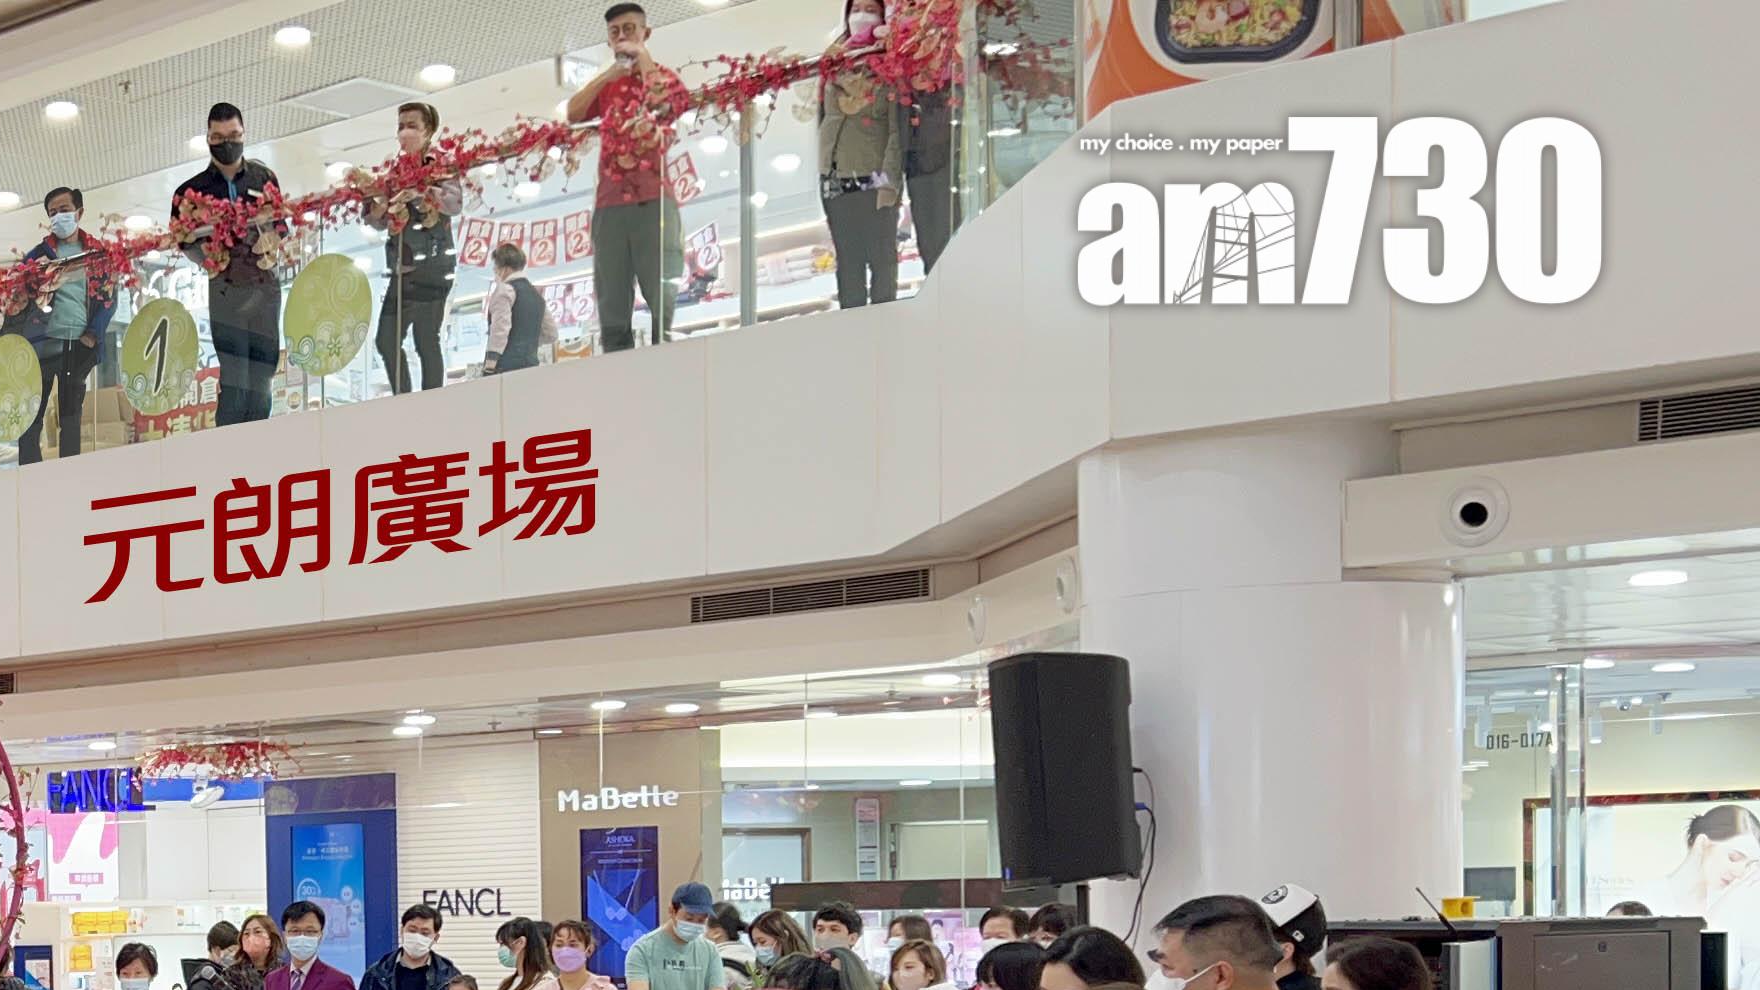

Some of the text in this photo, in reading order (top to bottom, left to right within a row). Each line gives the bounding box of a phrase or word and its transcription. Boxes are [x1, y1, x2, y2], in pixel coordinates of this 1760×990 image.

[83, 429, 599, 604] 元朗廣場
[47, 768, 145, 813] FANCL
[557, 784, 680, 813] MaBelle
[422, 887, 511, 918] FANCL
